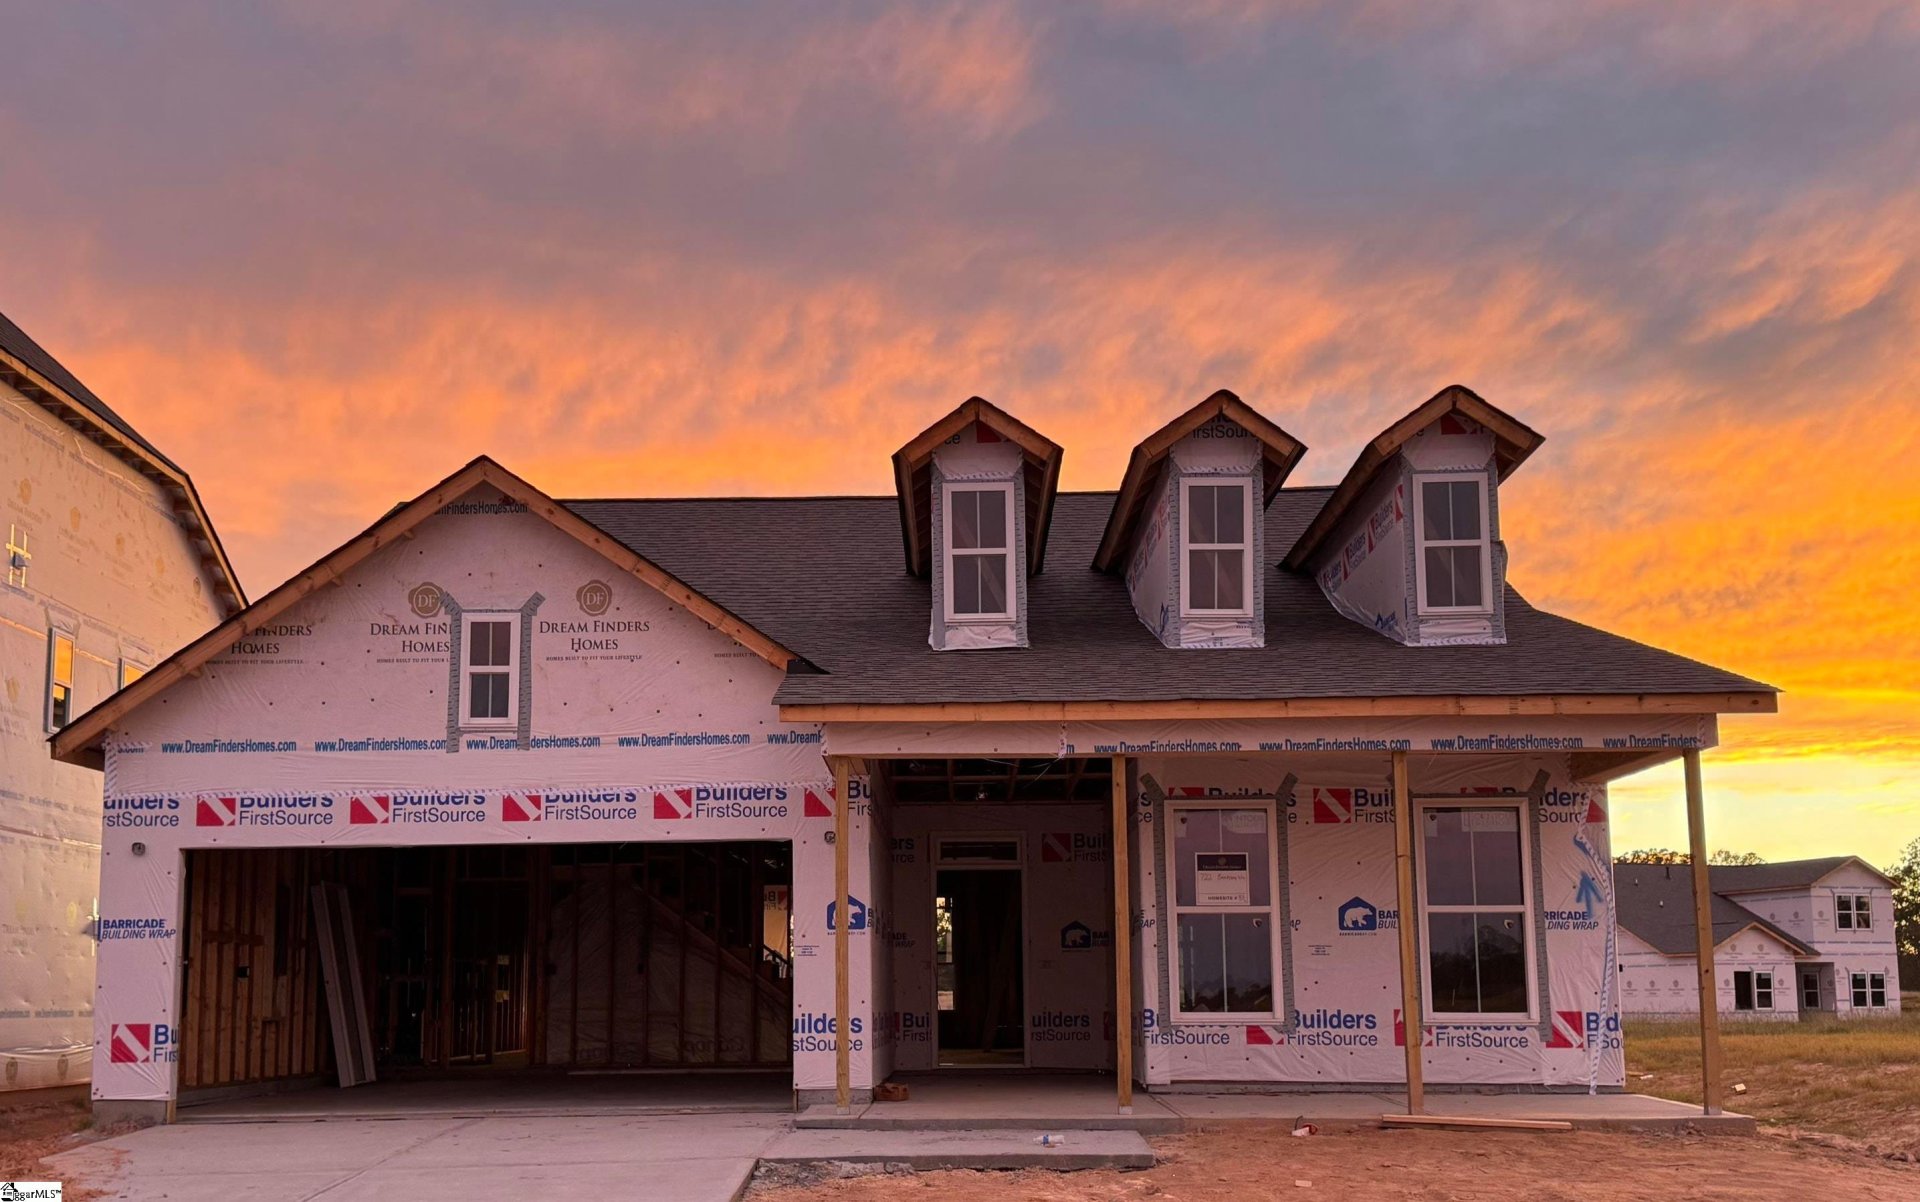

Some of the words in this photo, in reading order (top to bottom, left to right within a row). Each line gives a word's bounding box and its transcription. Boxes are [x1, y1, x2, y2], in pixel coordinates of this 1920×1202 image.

[162, 739, 297, 754] www.DreamFindersHomes.com
[466, 735, 600, 750] www.DreamdersHomes.com
[620, 731, 750, 748] www.DreamFindersHomes.com
[1094, 739, 1241, 753] wwwDreamFindersHomes.com
[1259, 737, 1411, 751] wwwDreamFindersHomes.com
[696, 786, 788, 801] Builders
[392, 808, 486, 824] FirstSource
[545, 805, 637, 821] FirstSource
[696, 802, 788, 818] FirstSource
[240, 810, 334, 827] FirstSource
[102, 919, 165, 929] BARRICADE
[1572, 920, 1600, 931] WRAP
[101, 929, 146, 940] BUILDING
[148, 928, 177, 940] WRAP
[793, 1013, 863, 1034] uildes
[1287, 1030, 1378, 1046] FirstSource
[1435, 1032, 1529, 1048] FirstSource
